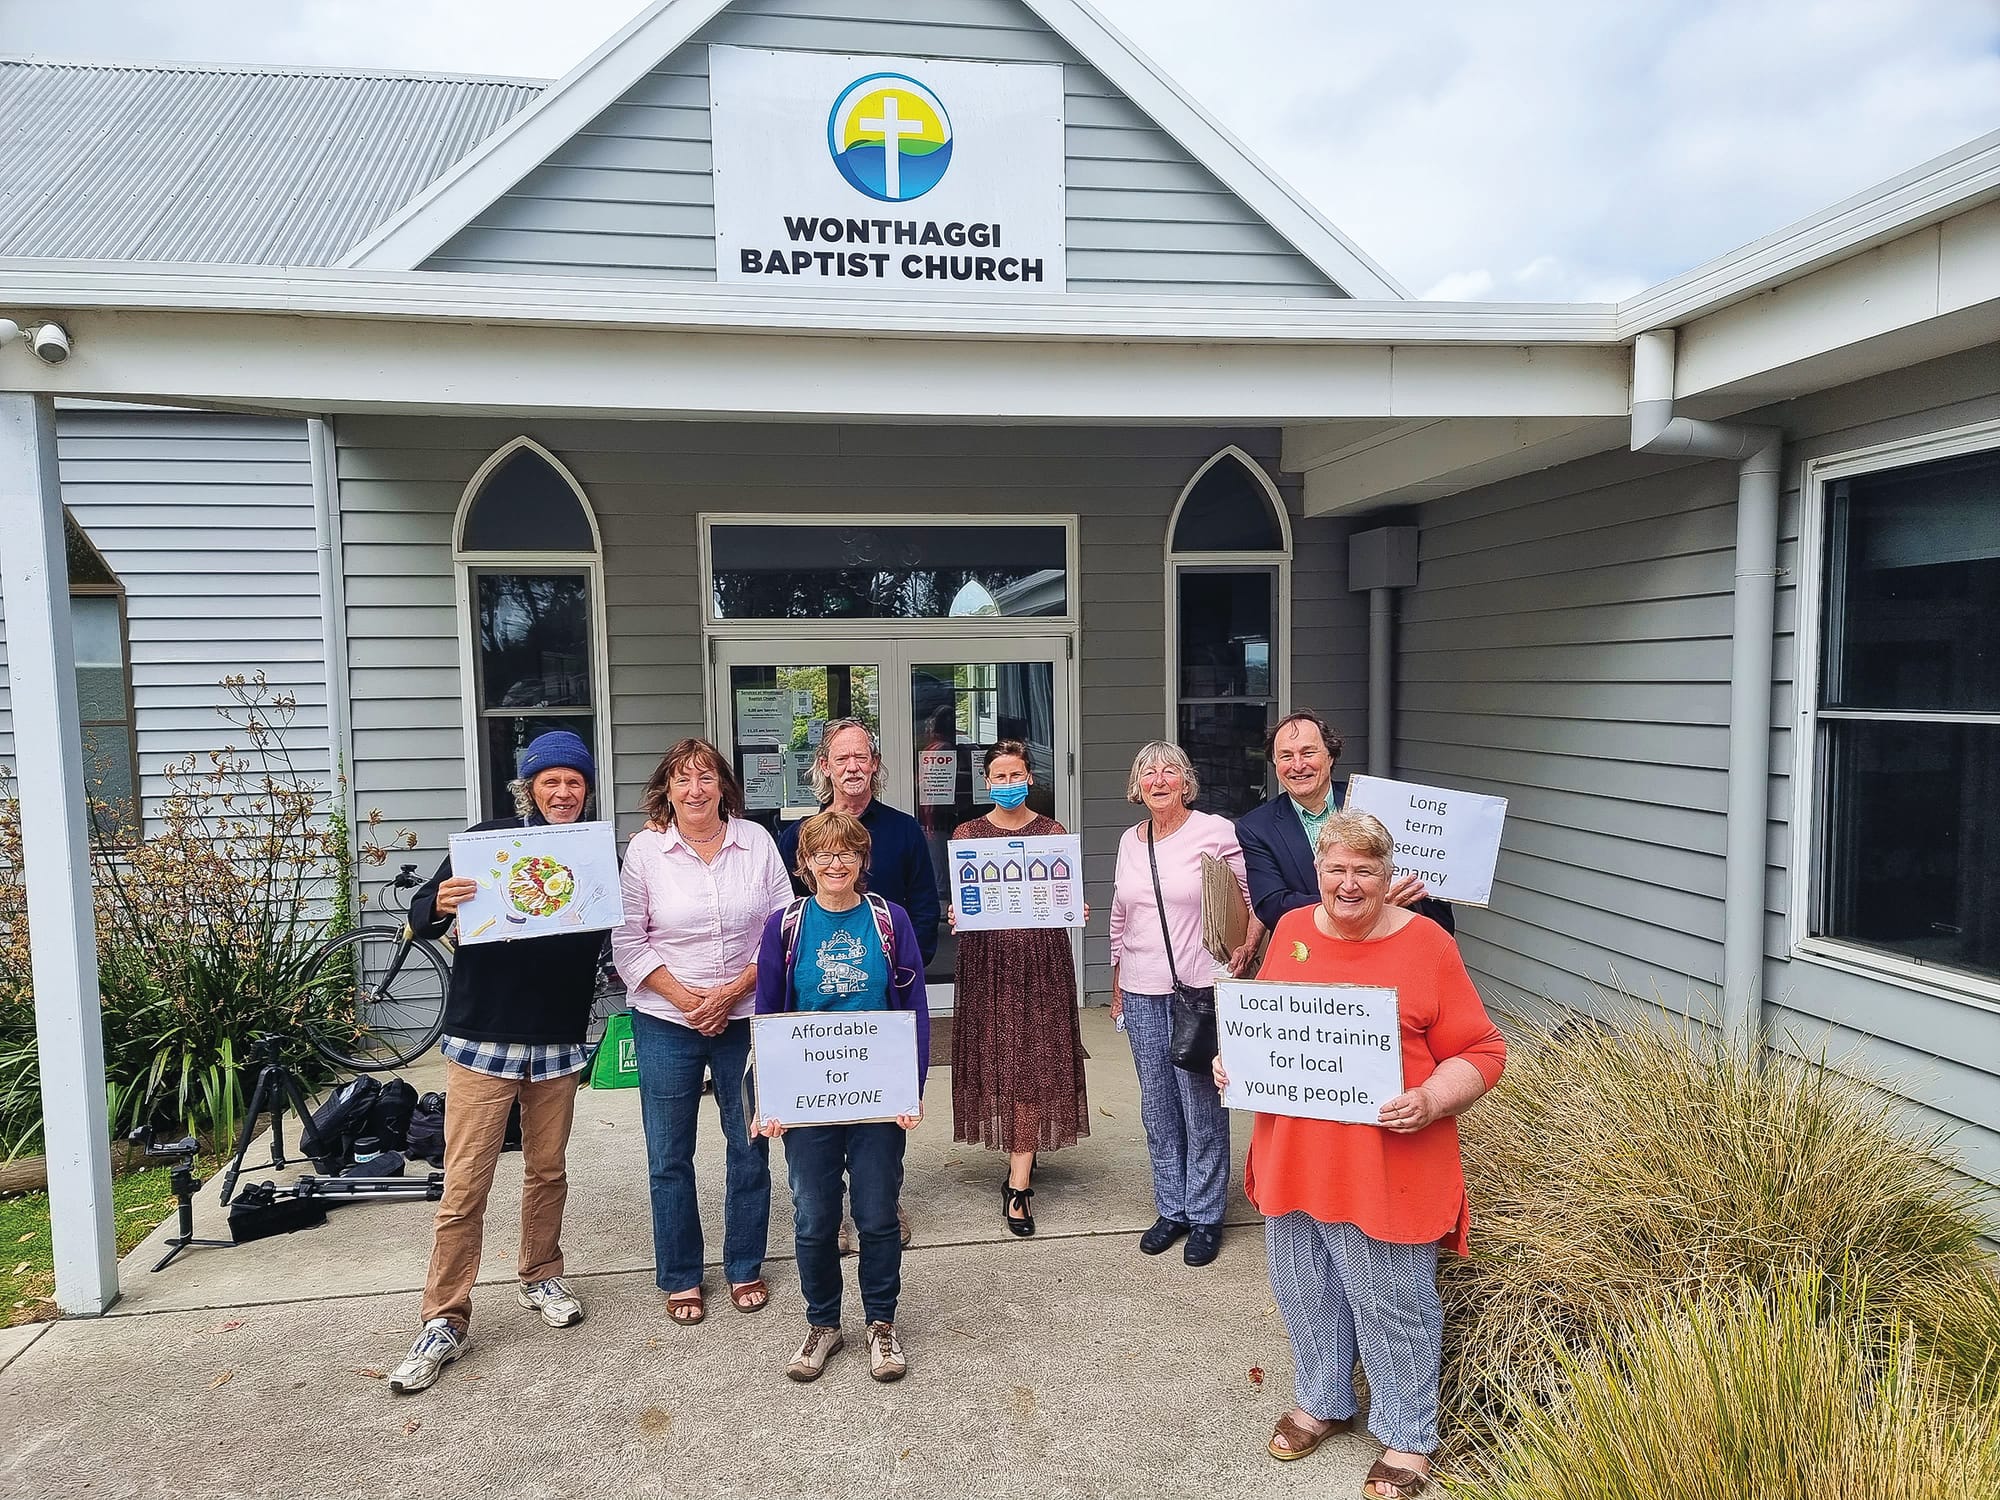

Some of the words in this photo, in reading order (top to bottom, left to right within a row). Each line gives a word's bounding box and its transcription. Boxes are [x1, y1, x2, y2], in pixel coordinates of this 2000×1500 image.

[784, 216, 1000, 248] WONTHAGGI
[740, 248, 889, 278] BAPTIST
[901, 254, 1043, 283] CHURCH
[923, 756, 953, 765] STOP
[1410, 794, 1448, 816] Long
[1405, 818, 1443, 836] term
[1394, 842, 1446, 860] secure
[1392, 865, 1447, 886] enancy
[1240, 994, 1283, 1012] Local
[1289, 995, 1370, 1017] builders.
[791, 1021, 878, 1040] Affordable
[1225, 1020, 1273, 1040] Work
[1277, 1025, 1310, 1042] and
[1315, 1028, 1391, 1052] training
[804, 1046, 869, 1062] housing
[1269, 1050, 1295, 1069] for
[1300, 1053, 1343, 1073] local
[825, 1069, 850, 1084] for
[796, 1089, 883, 1109] EVERYONE
[1244, 1080, 1298, 1102] young
[1304, 1085, 1374, 1106] people.
